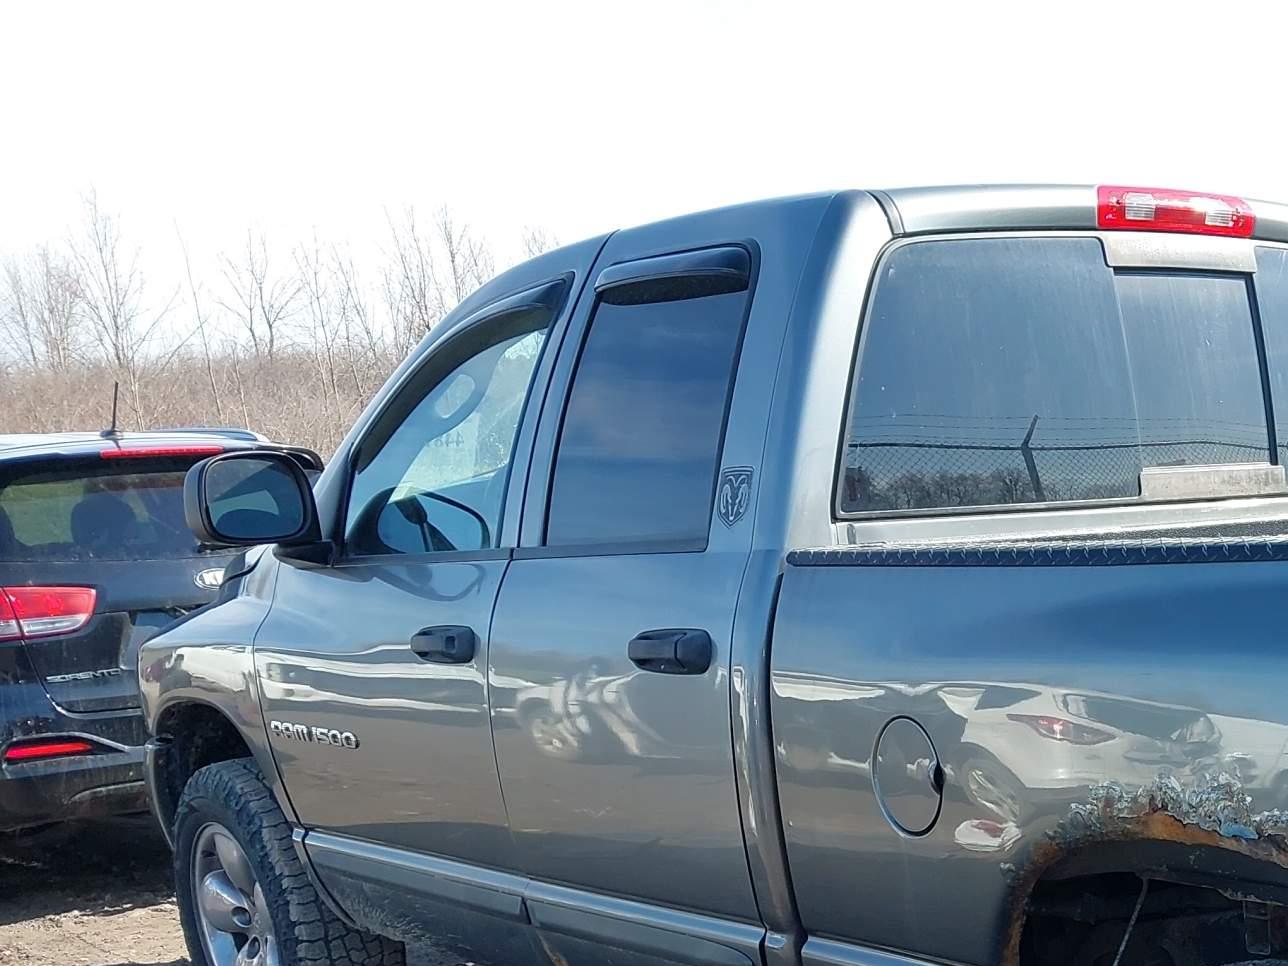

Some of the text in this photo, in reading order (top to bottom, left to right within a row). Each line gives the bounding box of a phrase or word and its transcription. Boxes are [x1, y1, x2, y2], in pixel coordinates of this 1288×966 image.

[45, 668, 121, 683] SORENTO
[270, 720, 358, 749] RAM 1500
